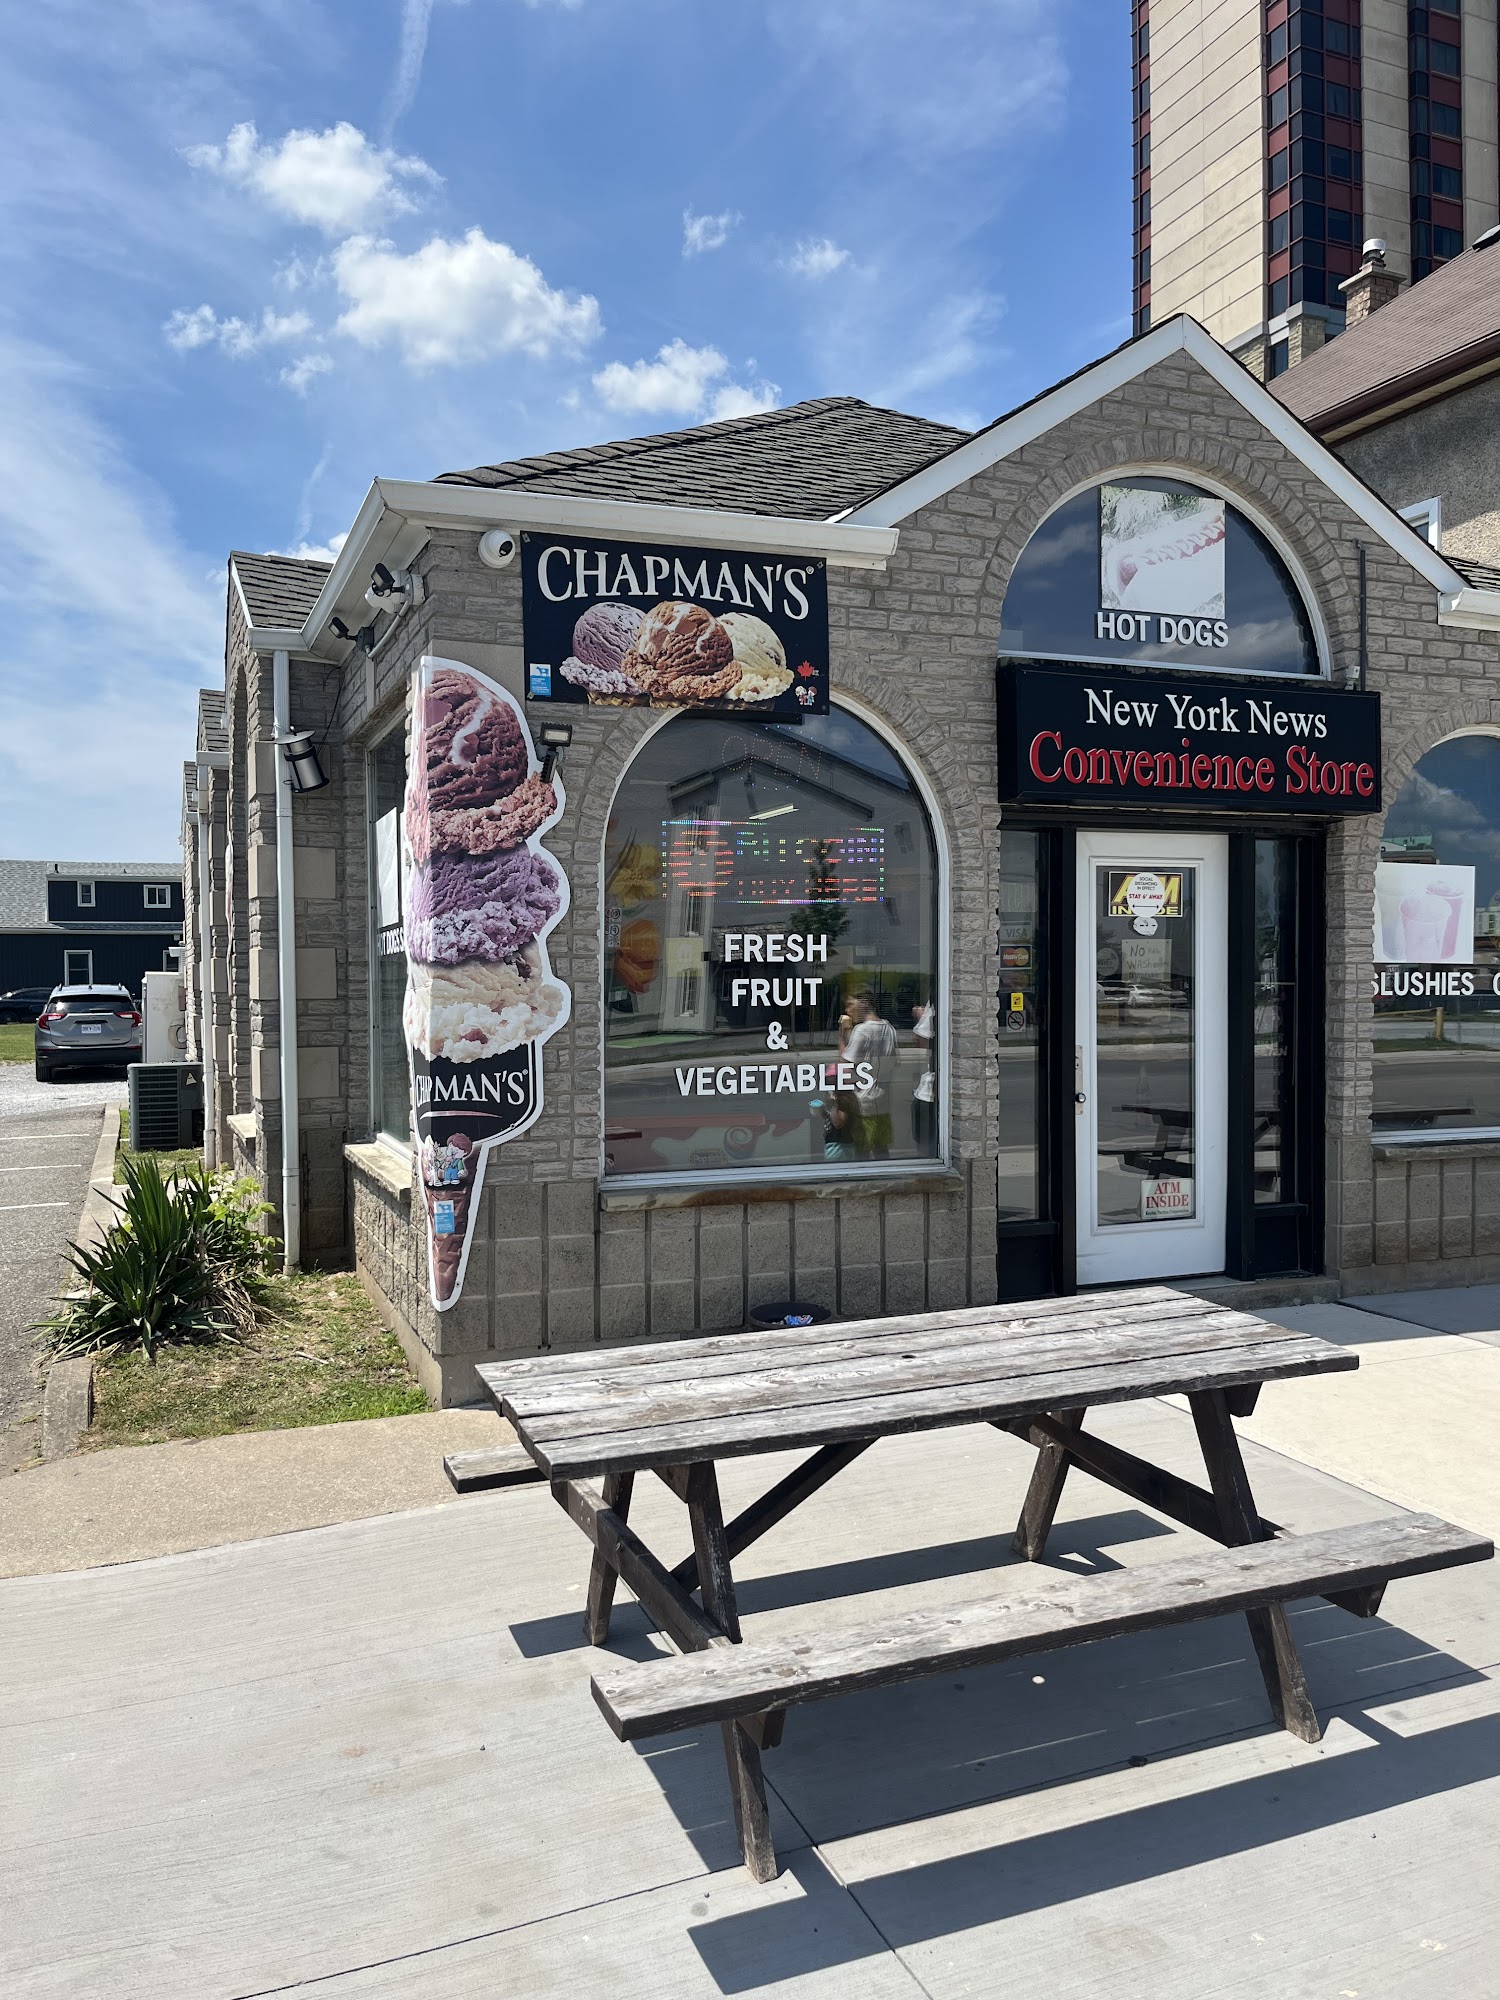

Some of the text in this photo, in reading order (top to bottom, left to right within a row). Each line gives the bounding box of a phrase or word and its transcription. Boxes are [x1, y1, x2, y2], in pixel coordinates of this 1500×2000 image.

[537, 546, 809, 620] CHAPMAN'S
[1097, 611, 1229, 648] HOT DOGS
[1084, 688, 1327, 738] New York News
[722, 736, 823, 779] OPEN
[1029, 730, 1374, 797] Convenience Store
[1111, 874, 1181, 905] AM
[1112, 906, 1178, 915] INDE
[724, 933, 827, 963] FRESH
[1005, 928, 1028, 938] VISA
[1130, 944, 1146, 957] NO
[731, 978, 823, 1007] FRUIT
[1370, 971, 1474, 996] SLUSHIES
[766, 1021, 789, 1050] &
[415, 1069, 526, 1109] CHAPMAN'S
[675, 1061, 874, 1097] VEGETABLES
[1146, 1194, 1189, 1209] INSIDE
[1154, 1181, 1181, 1195] ATM
